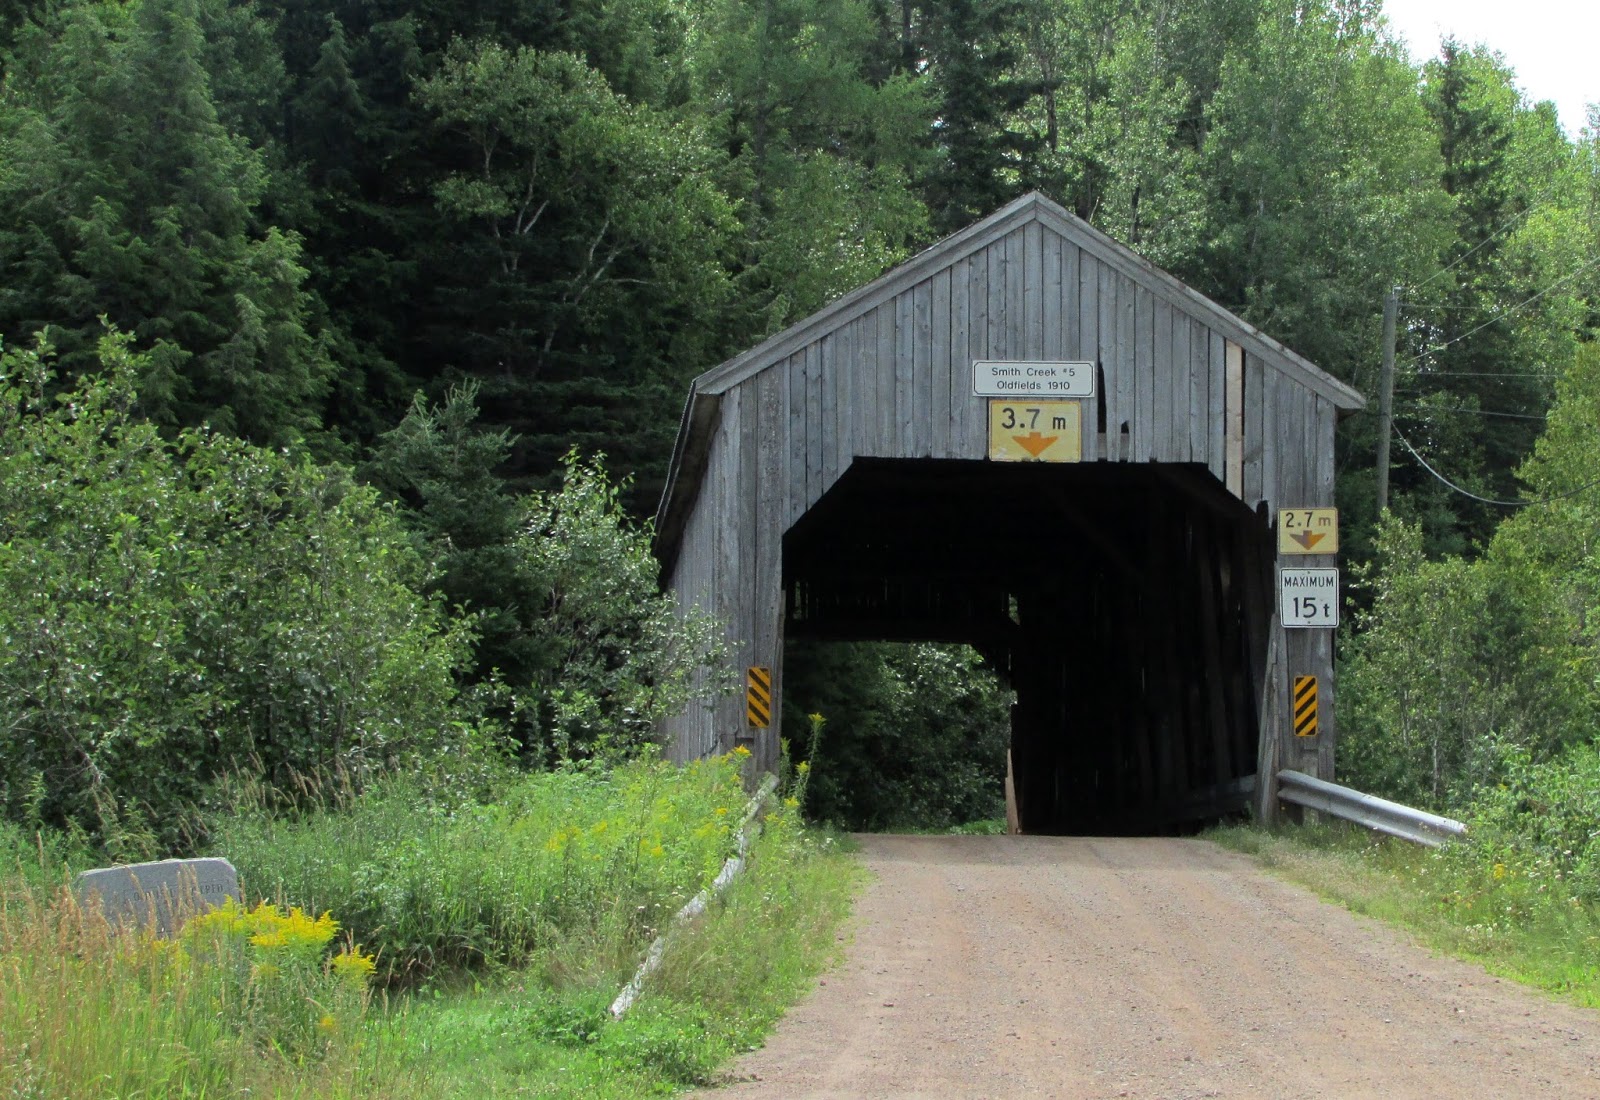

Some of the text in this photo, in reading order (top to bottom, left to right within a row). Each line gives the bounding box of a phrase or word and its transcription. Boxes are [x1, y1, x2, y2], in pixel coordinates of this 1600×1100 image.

[991, 367, 1021, 377] Smith
[1026, 367, 1057, 377] Creek
[996, 380, 1070, 390] Oldfields 1910
[1001, 408, 1066, 430] 3.7 m
[1285, 512, 1331, 528] 2.7 m
[1284, 576, 1334, 588] MAXIMUM
[1293, 597, 1330, 618] 15 t
